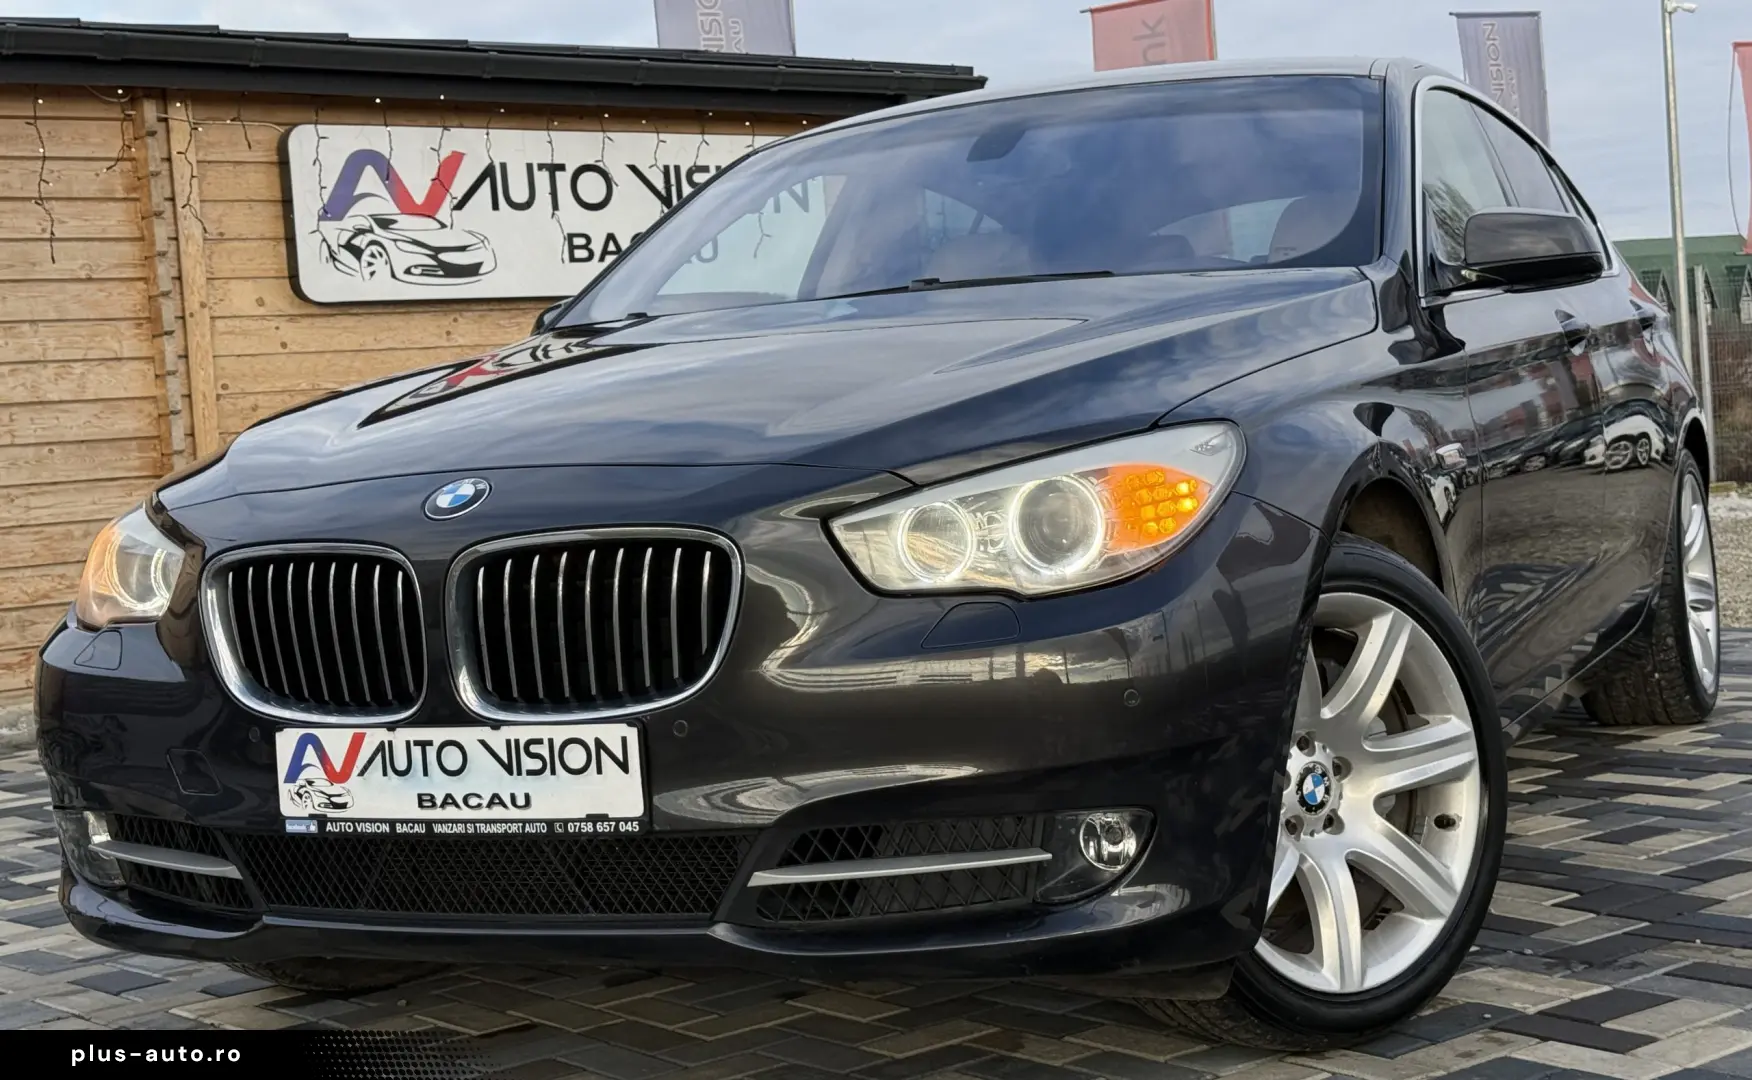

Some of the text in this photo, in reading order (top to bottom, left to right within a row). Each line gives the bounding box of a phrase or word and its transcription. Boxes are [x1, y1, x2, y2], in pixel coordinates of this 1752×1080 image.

[452, 161, 613, 212] AUTO
[357, 736, 630, 777] AUTO VISION
[417, 792, 531, 811] BACAU
[326, 821, 640, 834] AUTO VISION BACAU VANZARI SI TRANSPORT AUTO 0758 657 045
